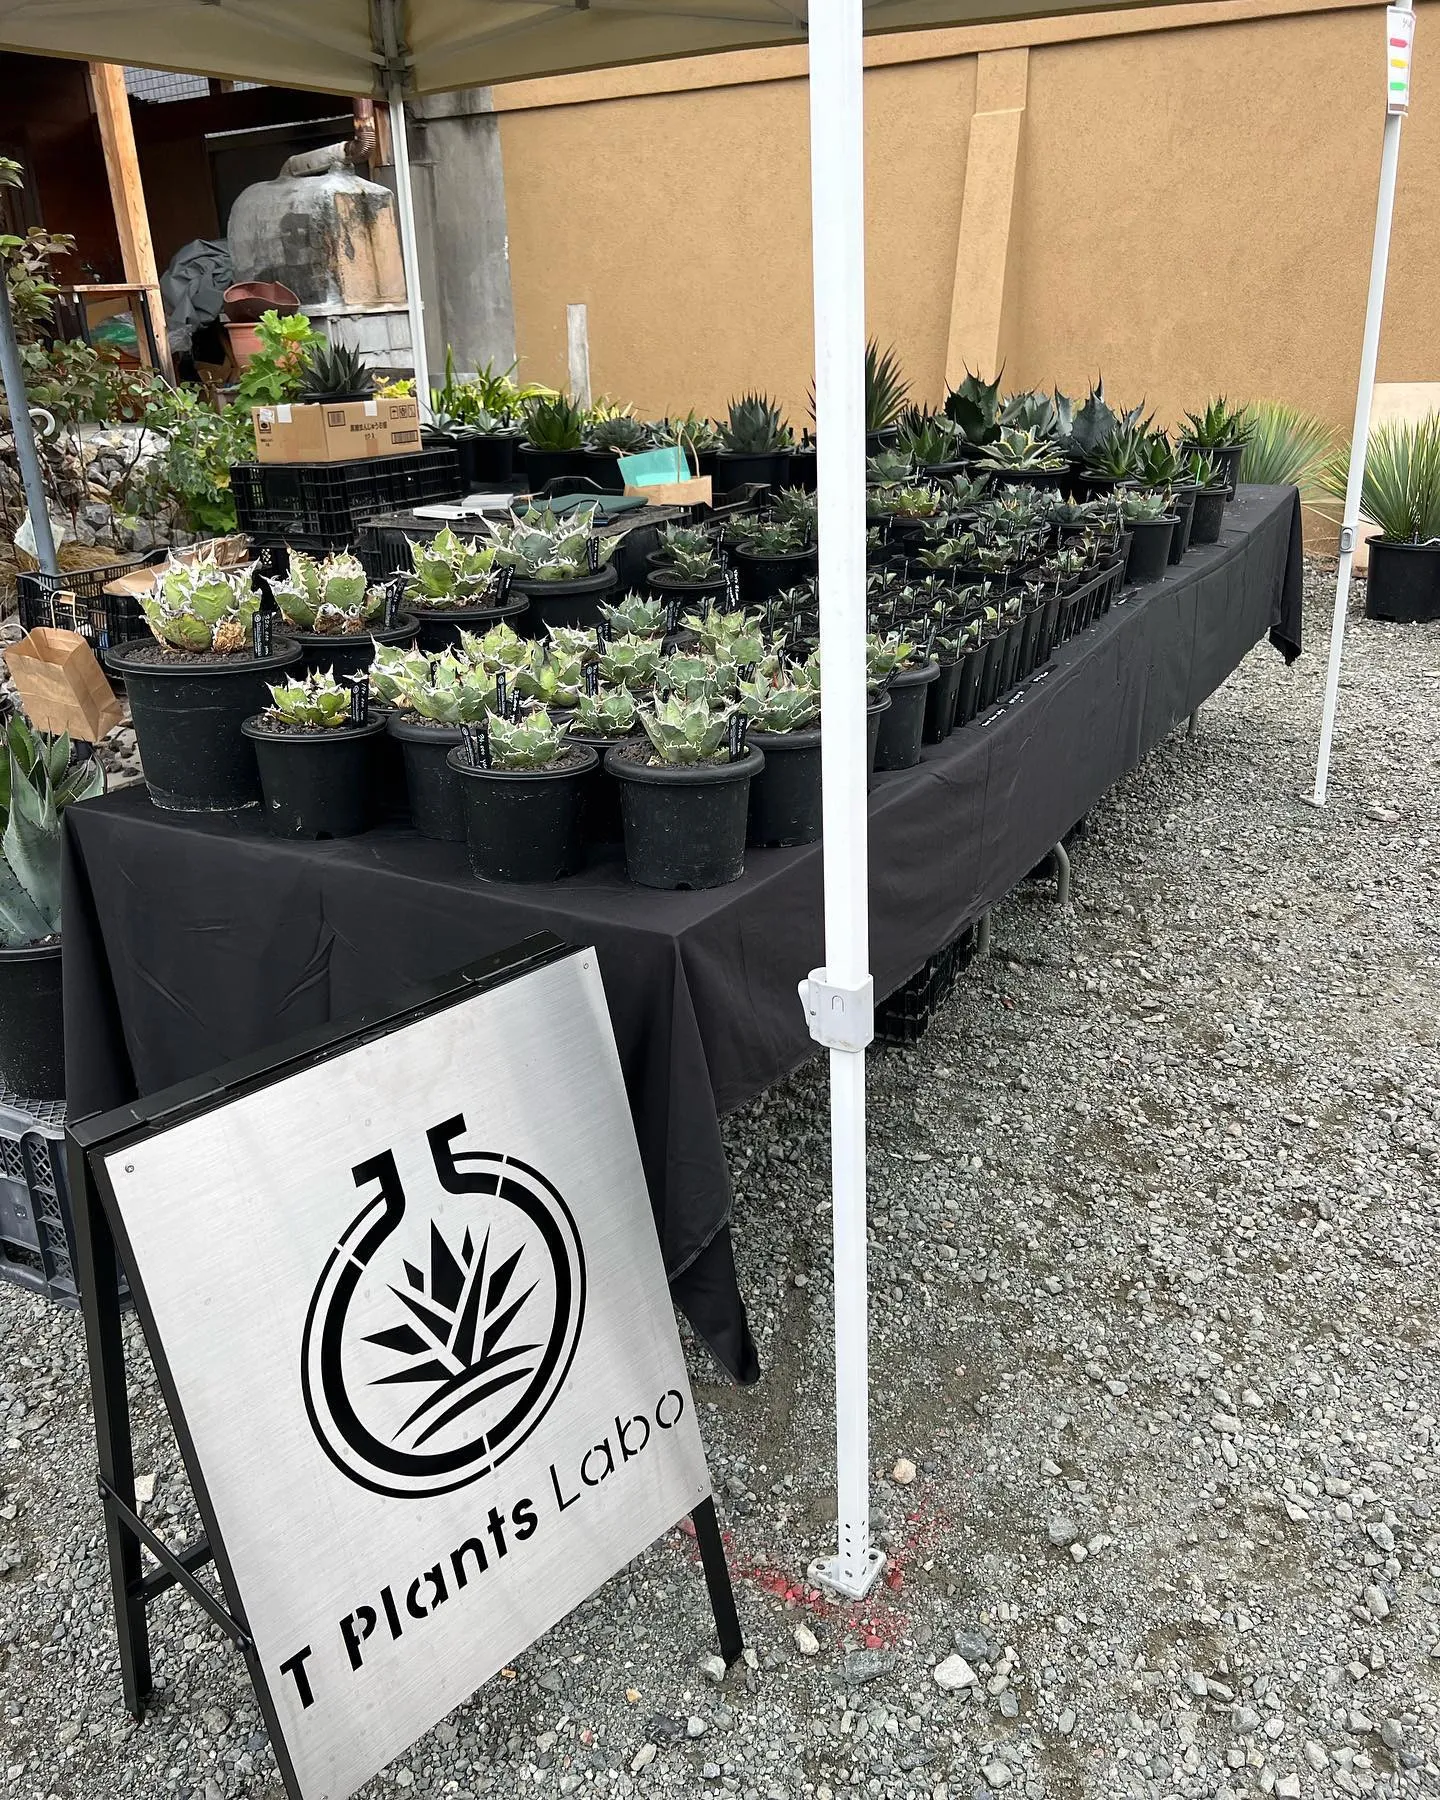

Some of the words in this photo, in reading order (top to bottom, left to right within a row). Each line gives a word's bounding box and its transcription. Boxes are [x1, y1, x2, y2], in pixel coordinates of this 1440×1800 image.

[280, 1645, 315, 1710] T
[339, 1498, 538, 1672] Plants
[550, 1389, 685, 1512] Labo
